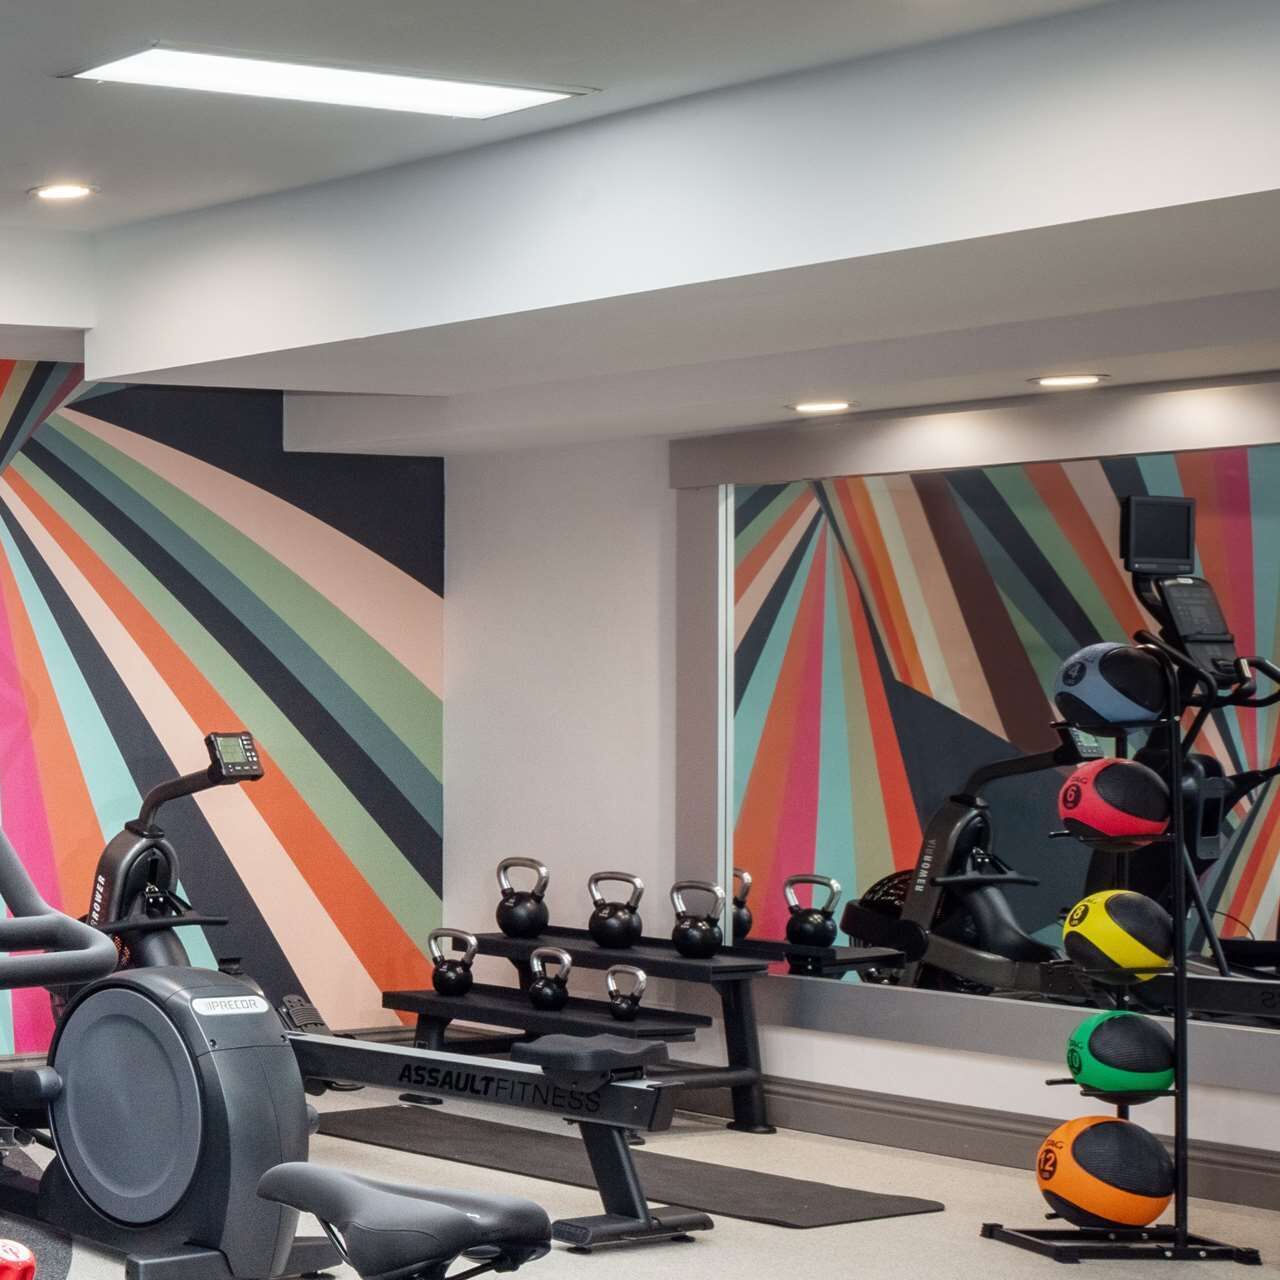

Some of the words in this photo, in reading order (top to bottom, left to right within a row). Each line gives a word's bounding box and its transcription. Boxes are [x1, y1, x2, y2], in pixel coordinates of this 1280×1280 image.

[1066, 785, 1078, 802] 6
[1073, 905, 1085, 919] 8
[211, 999, 258, 1012] PRECOR
[1040, 1151, 1056, 1172] 12
